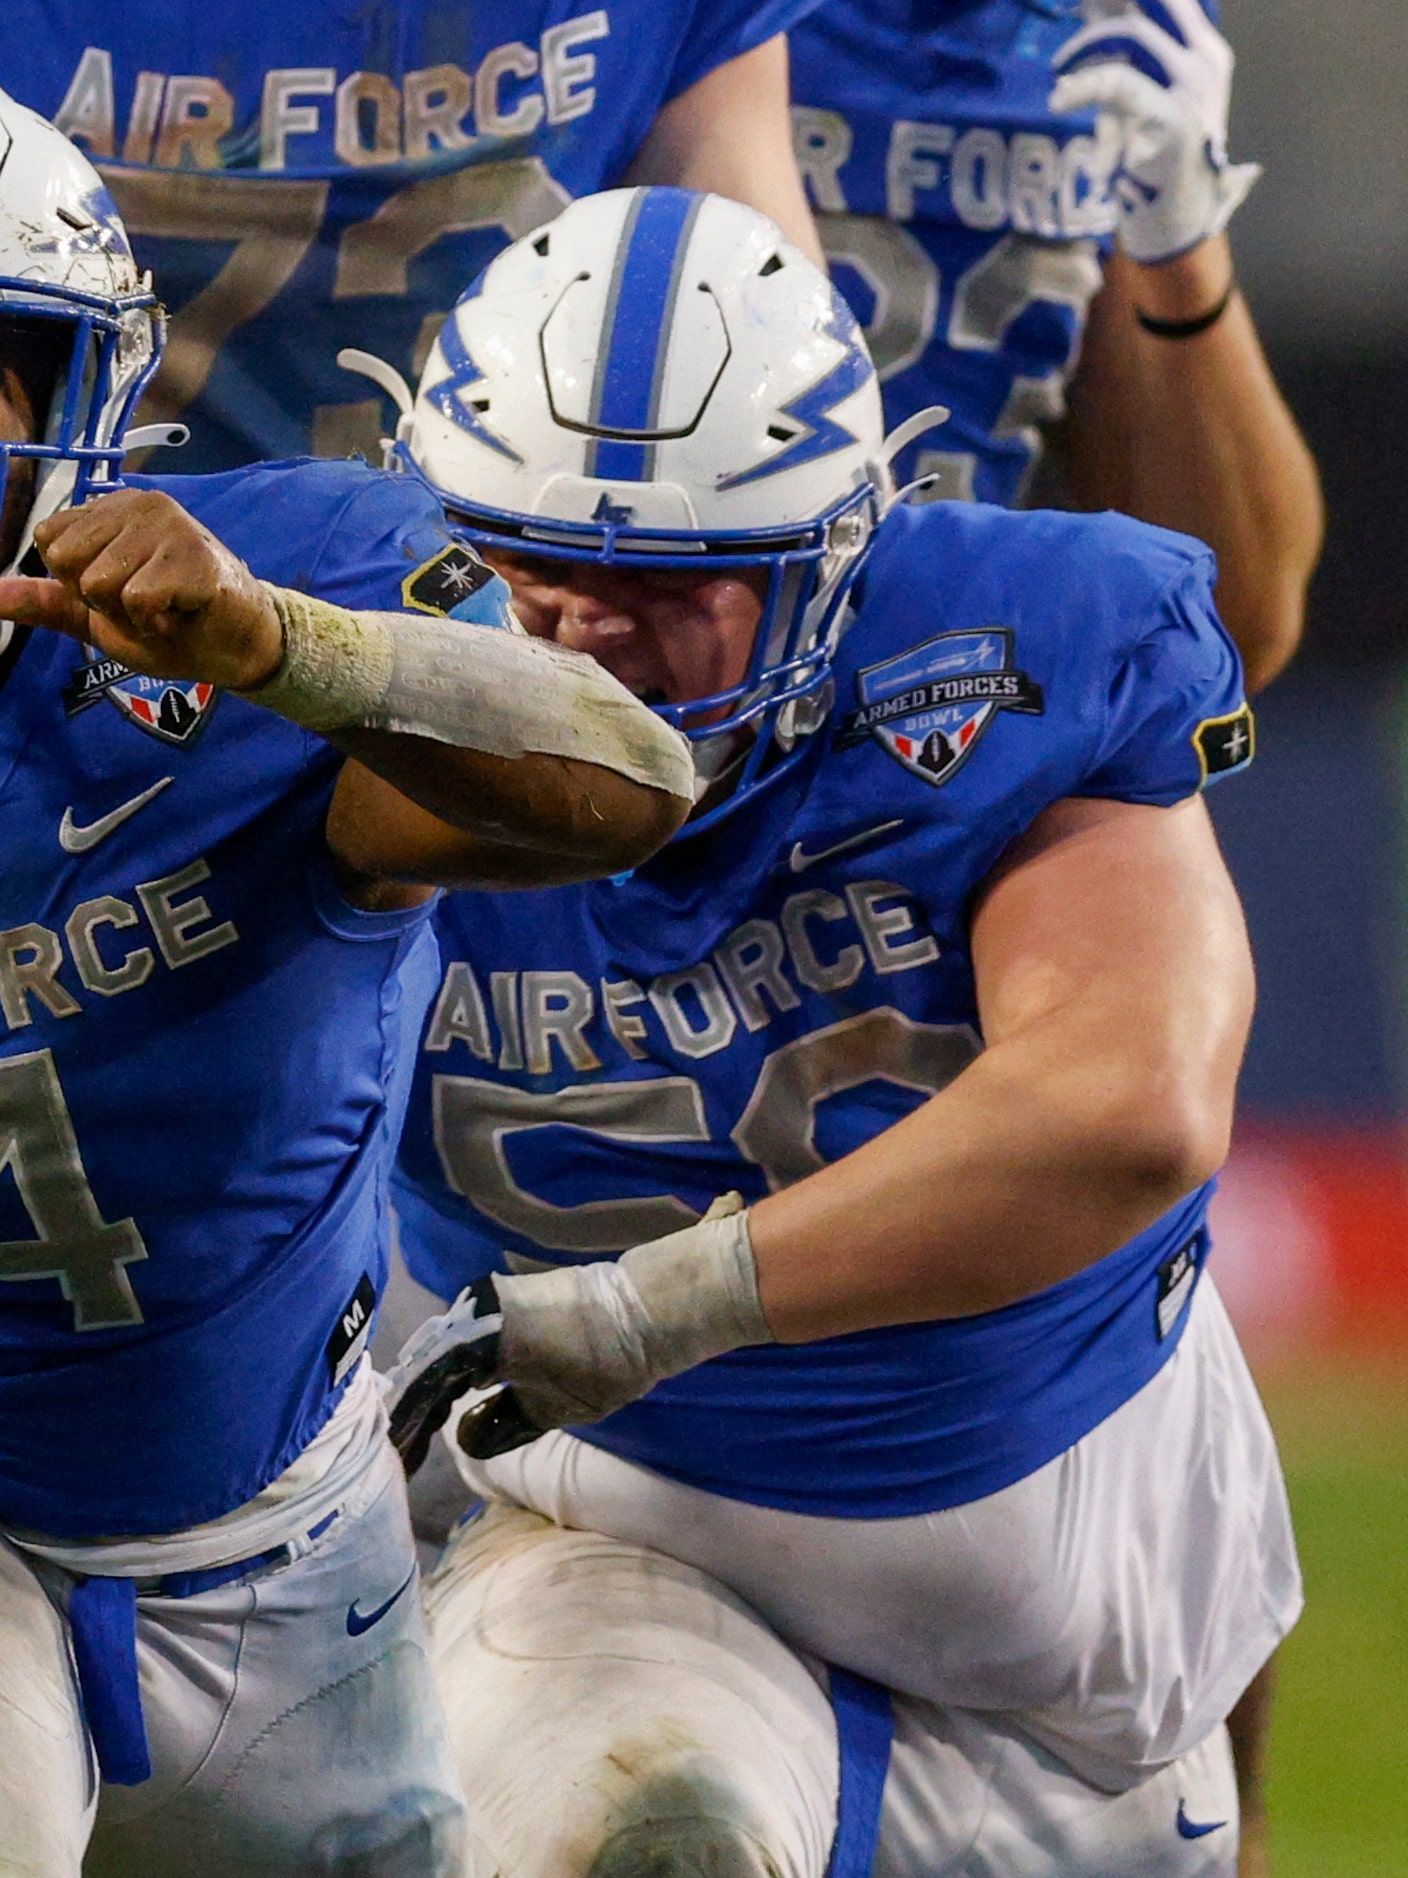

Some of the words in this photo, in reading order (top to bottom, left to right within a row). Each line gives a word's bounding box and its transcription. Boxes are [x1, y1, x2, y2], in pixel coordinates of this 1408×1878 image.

[55, 47, 232, 169] AIR
[259, 10, 610, 170] FORCE
[853, 688, 927, 728] ARMED
[930, 674, 1020, 703] FORCES
[904, 711, 965, 732] BOWL
[425, 961, 601, 1075] AIR
[601, 880, 941, 1060] FORCE
[343, 1299, 365, 1338] M
